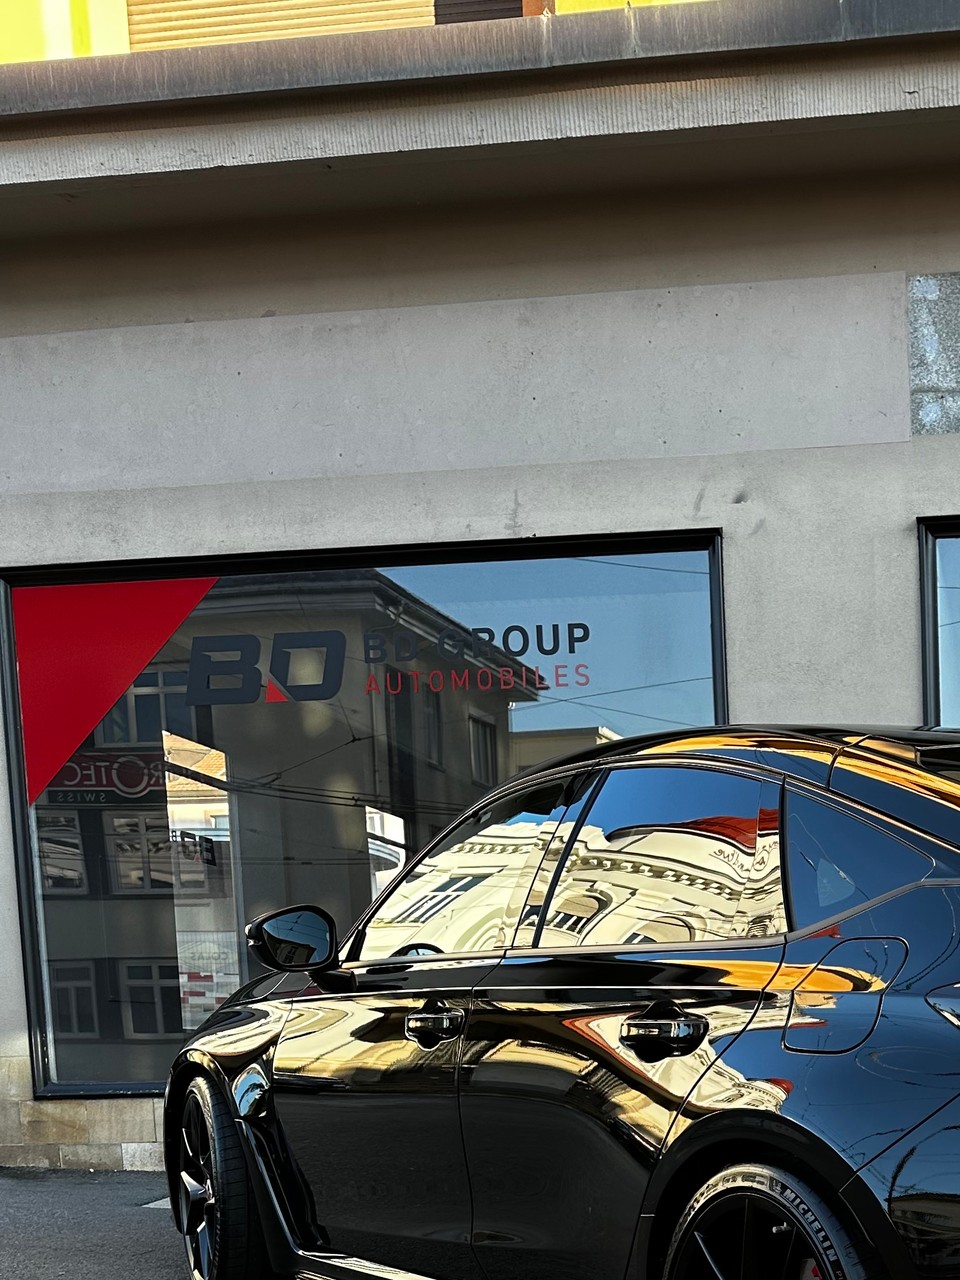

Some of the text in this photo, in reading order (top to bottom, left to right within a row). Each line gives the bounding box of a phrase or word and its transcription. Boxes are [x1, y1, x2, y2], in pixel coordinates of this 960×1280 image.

[185, 629, 347, 706] BD
[365, 623, 591, 664] BD GROUP
[365, 664, 591, 695] AUTOMOBILES
[783, 1188, 839, 1262] MICHELIN
